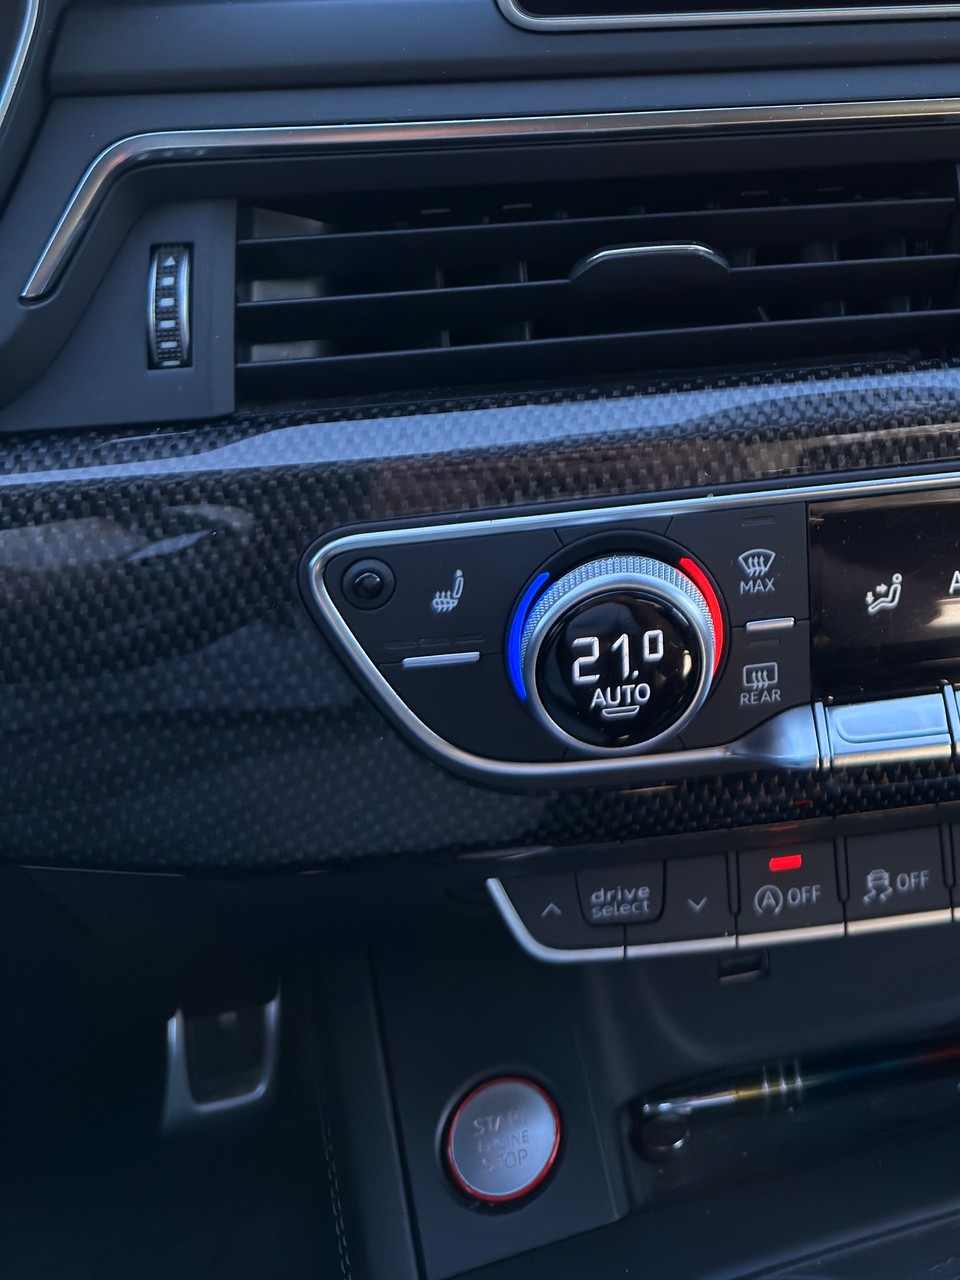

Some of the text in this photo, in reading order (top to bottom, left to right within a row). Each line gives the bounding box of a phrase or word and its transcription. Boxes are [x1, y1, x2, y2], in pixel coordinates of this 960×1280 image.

[740, 578, 776, 595] MAX
[590, 683, 651, 710] AUTO
[740, 689, 782, 706] REAR
[897, 870, 930, 891] OFF
[590, 885, 650, 906] drive
[787, 885, 822, 906] OFF
[590, 899, 650, 918] select
